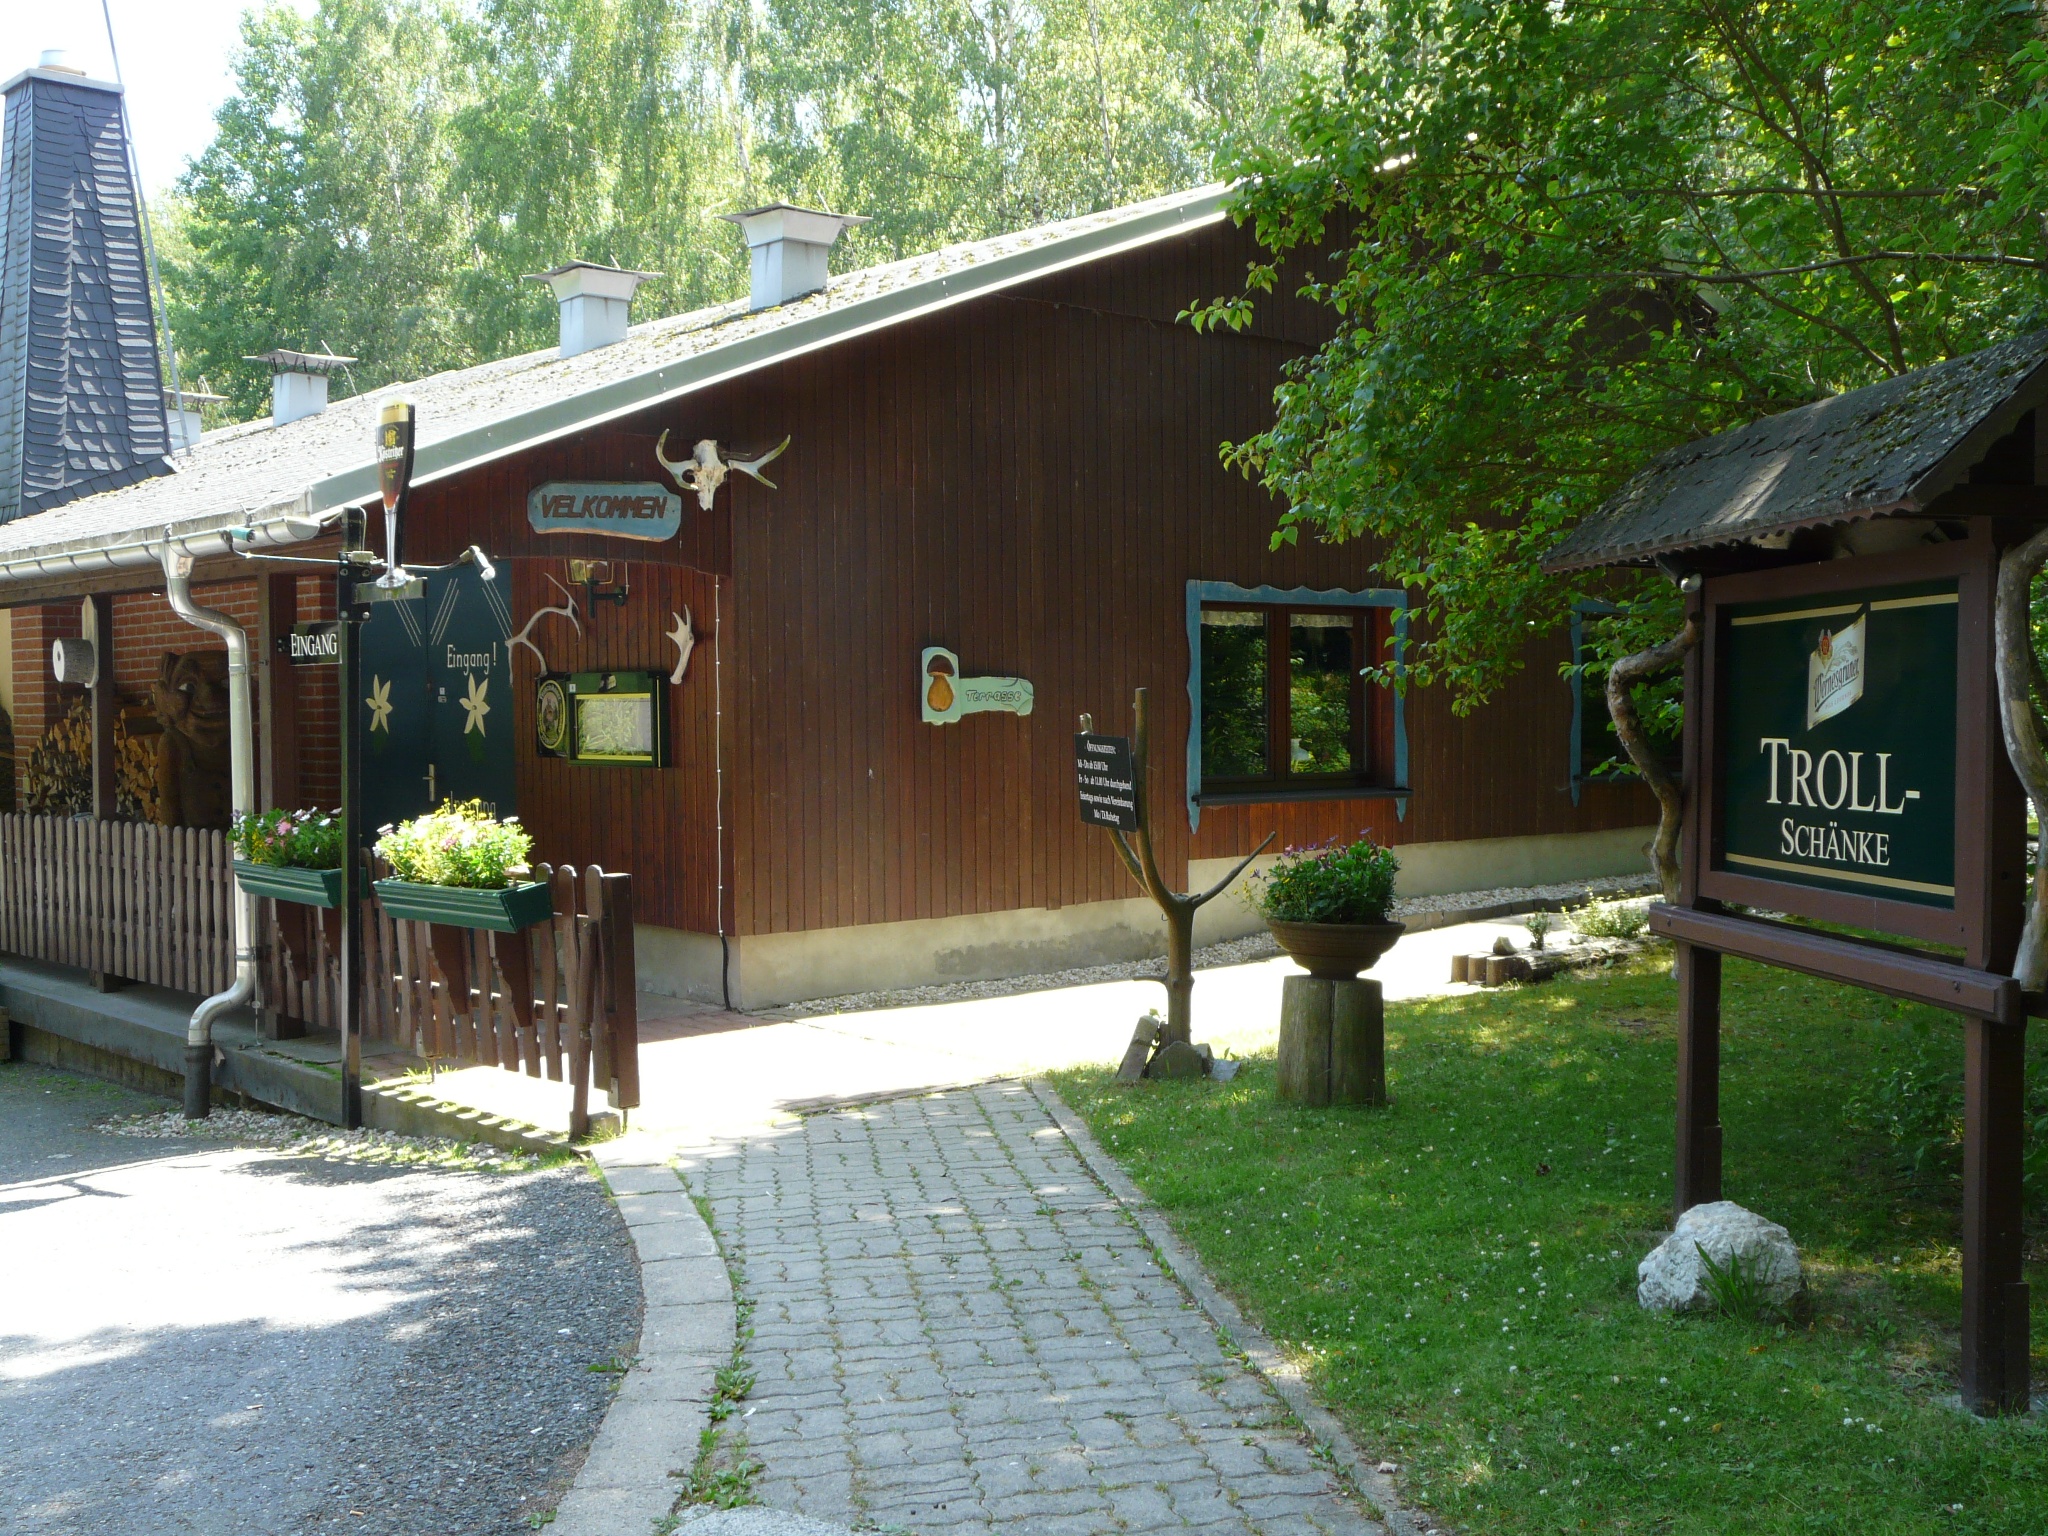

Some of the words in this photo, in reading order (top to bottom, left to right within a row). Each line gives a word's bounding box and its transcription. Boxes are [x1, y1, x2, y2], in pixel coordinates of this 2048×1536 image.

[541, 494, 668, 519] VELKOMMEN
[290, 633, 338, 657] EINGANG
[966, 689, 1022, 702] Terrasse
[1760, 737, 1921, 815] TROLL-
[1781, 818, 1890, 866] SCHÄNKE
